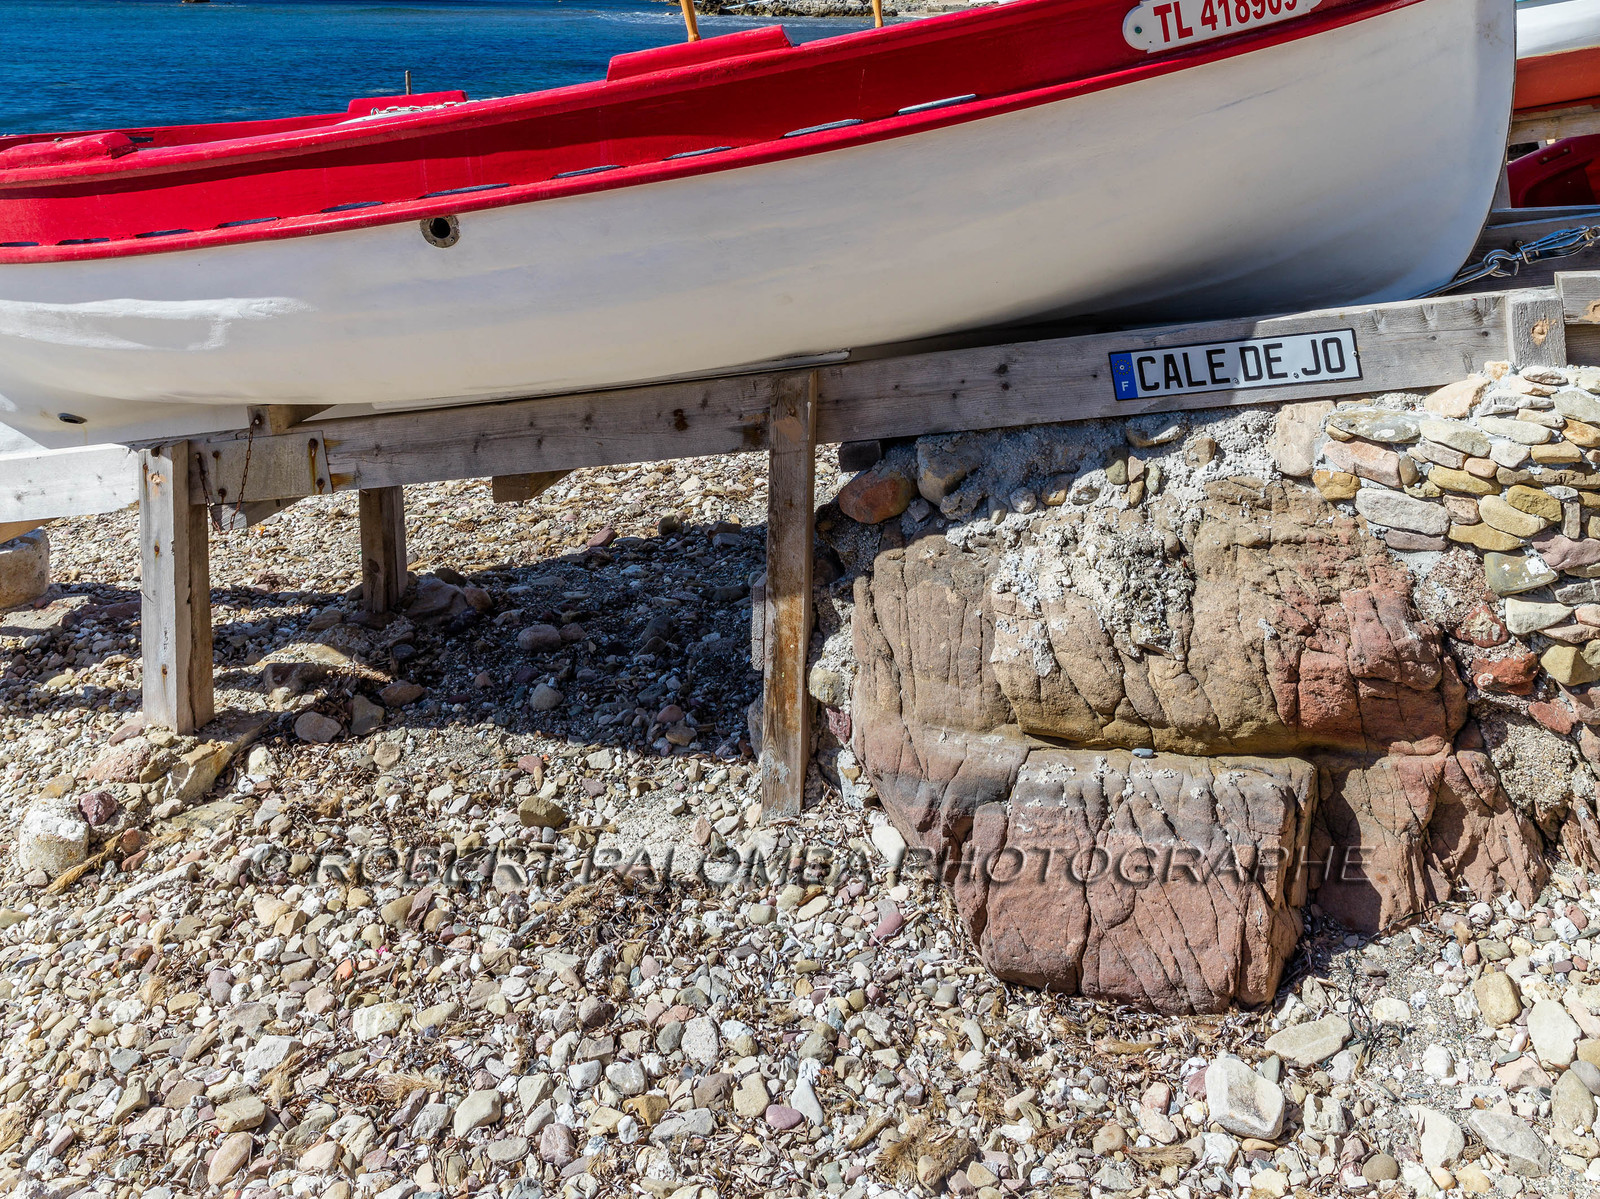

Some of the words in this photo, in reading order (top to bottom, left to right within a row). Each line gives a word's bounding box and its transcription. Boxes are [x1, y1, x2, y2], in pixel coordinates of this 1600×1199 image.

[1153, 1, 1193, 43] TL
[1301, 337, 1347, 376] JO
[1121, 380, 1129, 392] F
